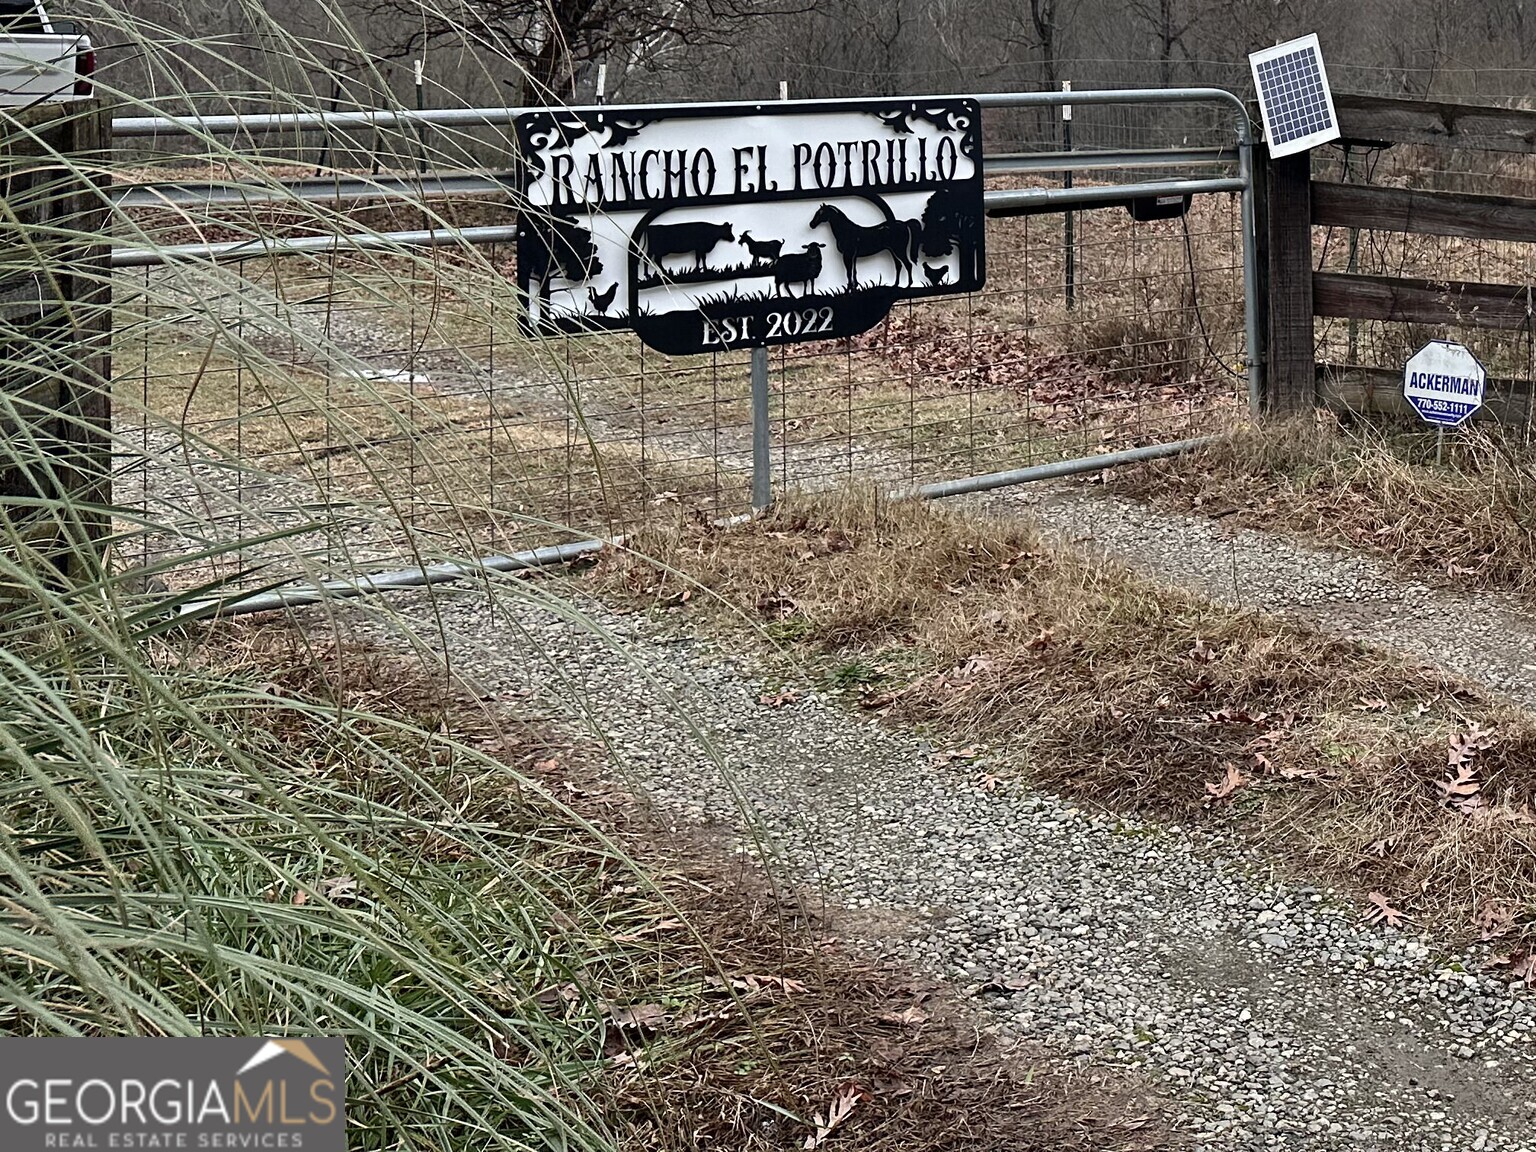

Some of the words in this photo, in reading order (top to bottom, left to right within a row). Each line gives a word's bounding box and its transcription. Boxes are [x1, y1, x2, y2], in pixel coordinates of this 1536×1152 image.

[551, 147, 716, 205] RANCHO
[733, 144, 778, 195] EL
[793, 135, 957, 191] POTRILLO
[702, 316, 756, 346] EST.
[766, 306, 834, 339] 2022
[1409, 371, 1479, 396] ACKERMAN
[1417, 398, 1468, 414] 770-552-1111
